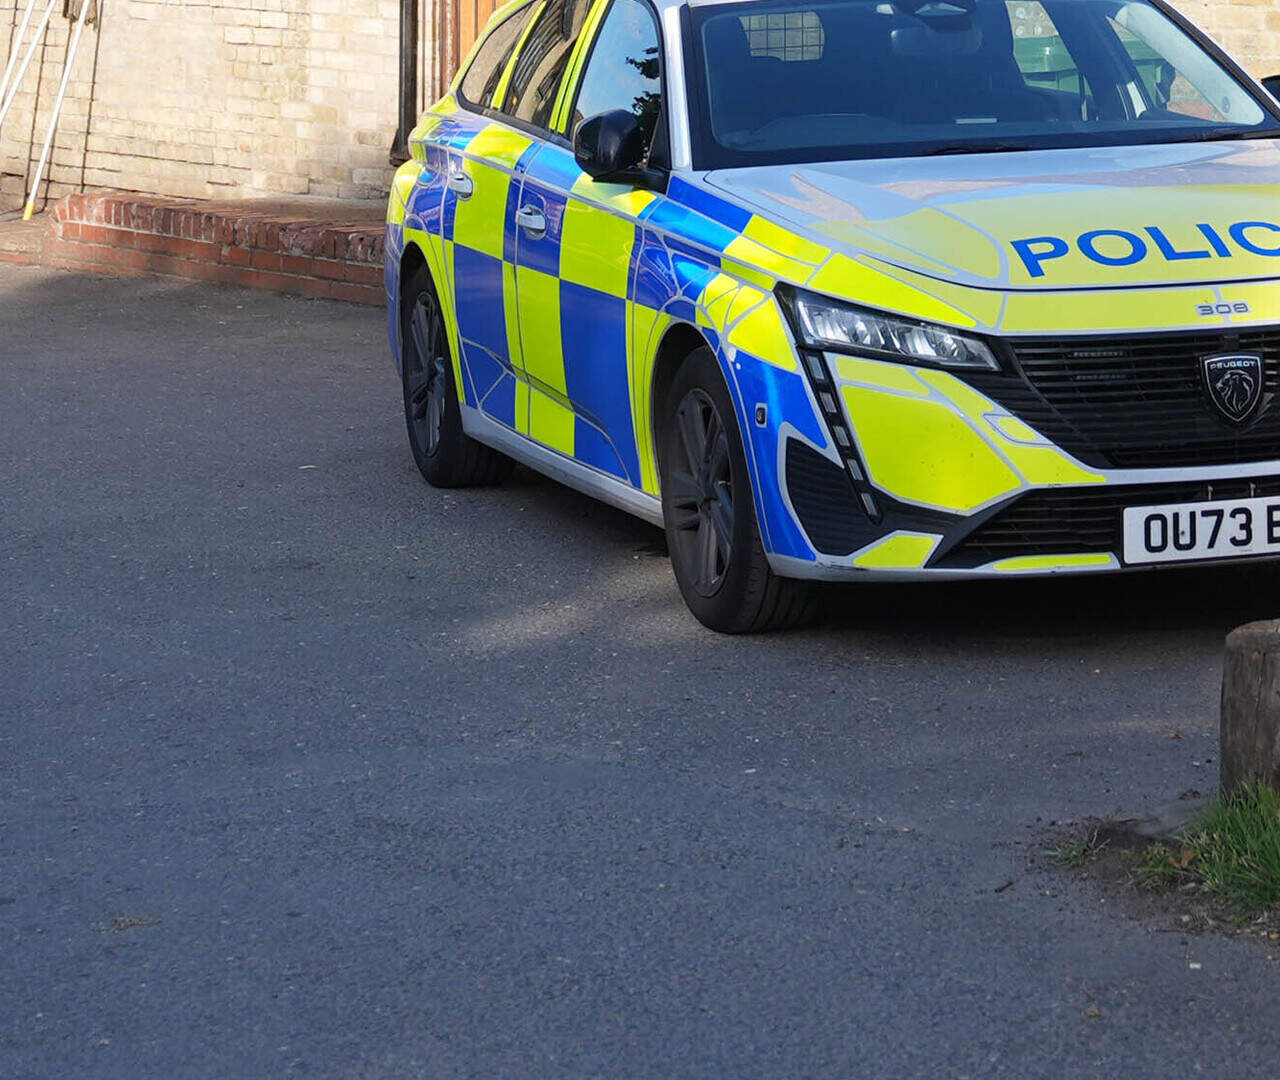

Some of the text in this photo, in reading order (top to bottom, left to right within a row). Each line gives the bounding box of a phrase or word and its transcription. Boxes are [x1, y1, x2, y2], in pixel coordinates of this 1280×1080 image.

[1197, 303, 1249, 316] 308
[1209, 360, 1257, 369] PEUGEOT
[1144, 507, 1253, 553] OU73
